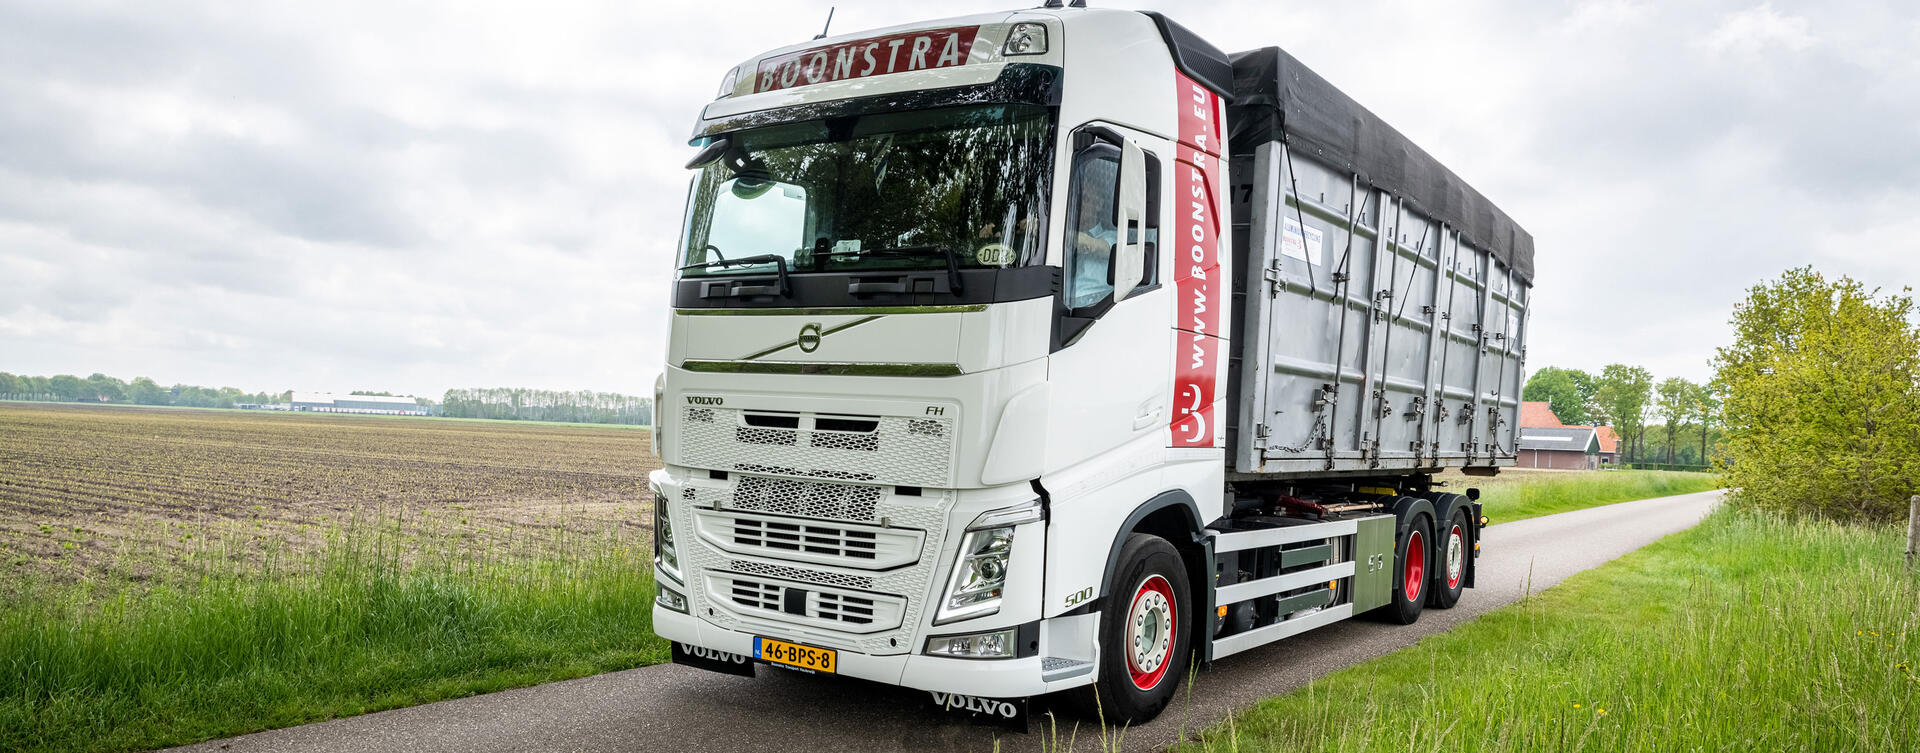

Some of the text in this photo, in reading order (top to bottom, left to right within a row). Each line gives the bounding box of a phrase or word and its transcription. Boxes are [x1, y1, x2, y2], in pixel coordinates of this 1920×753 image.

[761, 32, 959, 92] BOONSTRA
[687, 396, 723, 405] VOLVO
[925, 406, 944, 415] FH
[1065, 586, 1093, 608] 500
[681, 643, 746, 664] VOLVO
[765, 642, 830, 669] 46-BPS-8
[930, 691, 1017, 718] VOLVO
